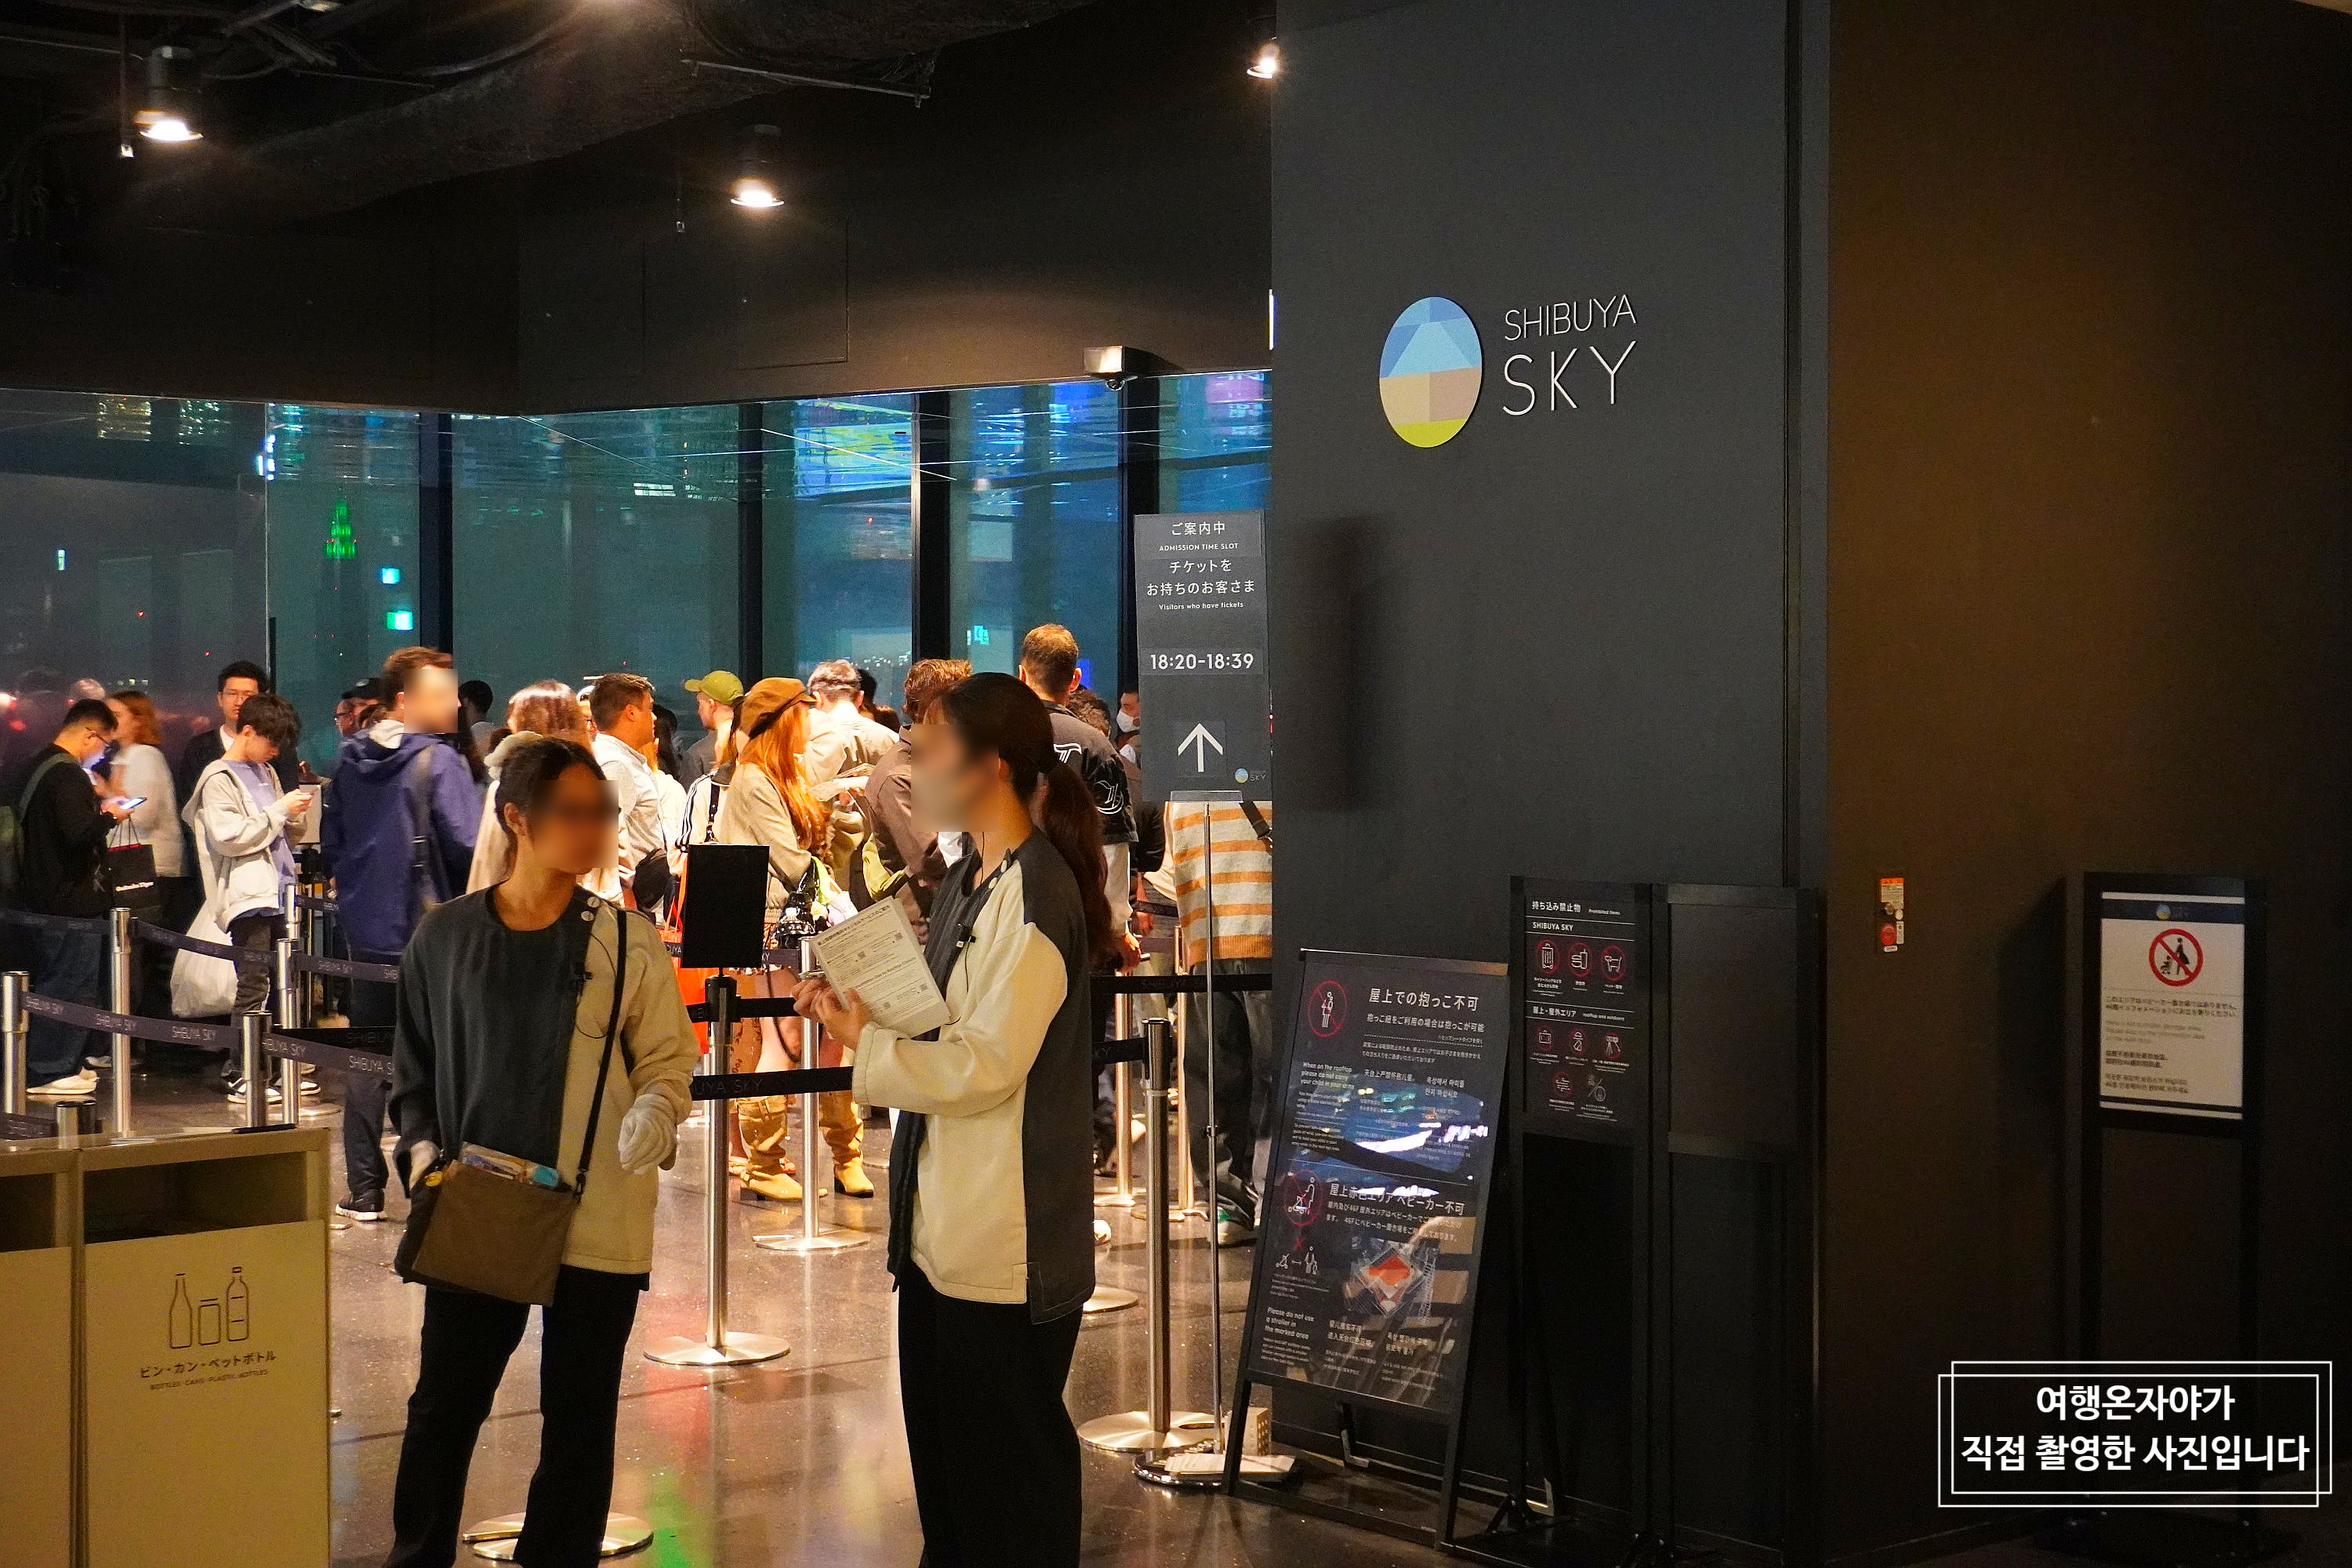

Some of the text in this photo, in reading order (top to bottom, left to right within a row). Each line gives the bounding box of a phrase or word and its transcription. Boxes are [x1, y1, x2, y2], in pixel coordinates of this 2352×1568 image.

[1504, 294, 1636, 341] SHIBUYA
[1503, 340, 1636, 416] SKY
[1171, 521, 1225, 535] ご案内中
[1170, 559, 1232, 573] チケットを
[1147, 580, 1254, 596] お持ちのお客さま
[1150, 653, 1254, 670] 18:20-18:39
[1532, 901, 1581, 913] 持ち込み禁止物
[1533, 922, 1573, 932] SHIBUYA SKY
[1369, 988, 1479, 1011] 屋上での抱っこ不可
[140, 1350, 276, 1378] ビン・カン・ペットボトル
